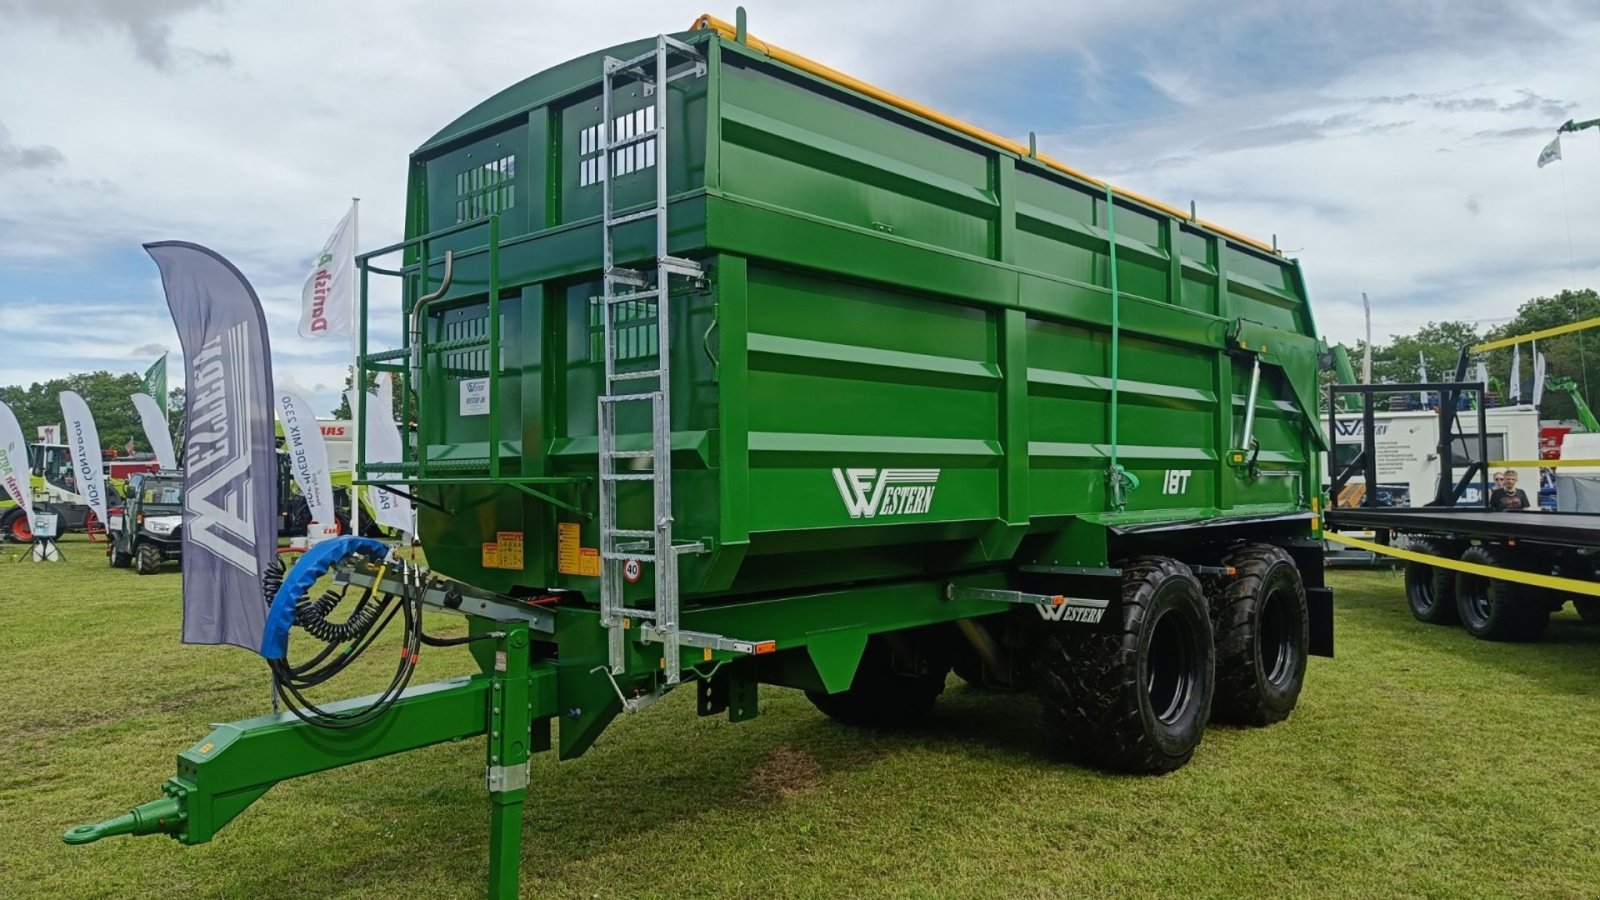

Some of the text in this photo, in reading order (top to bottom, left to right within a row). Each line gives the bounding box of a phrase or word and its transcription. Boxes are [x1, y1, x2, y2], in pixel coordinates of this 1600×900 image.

[832, 468, 941, 518] WESTERN
[1162, 469, 1192, 495] 18T
[627, 564, 638, 576] 40
[1035, 598, 1110, 624] WESTERN
